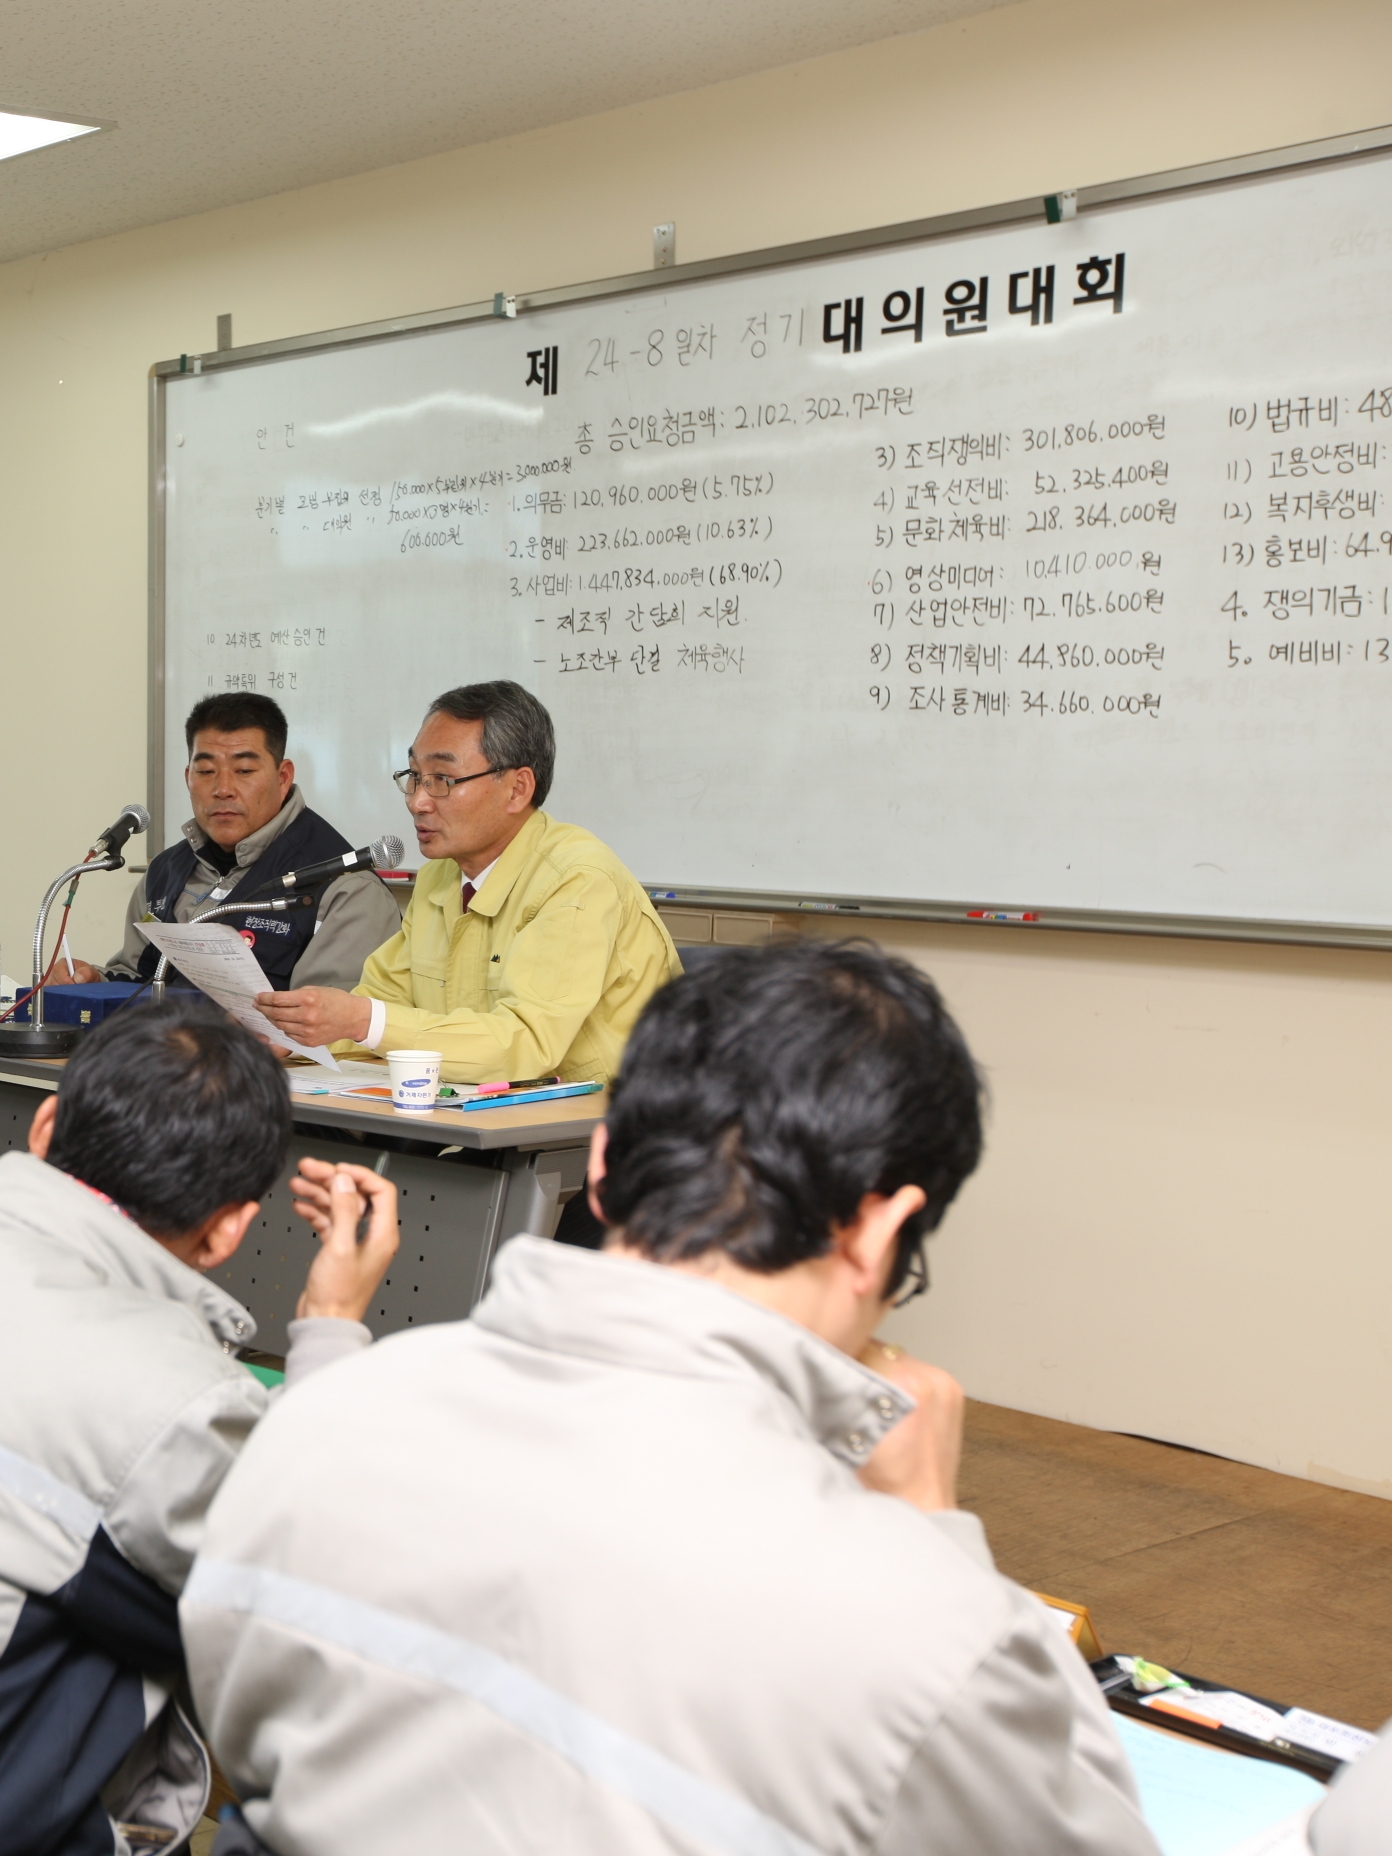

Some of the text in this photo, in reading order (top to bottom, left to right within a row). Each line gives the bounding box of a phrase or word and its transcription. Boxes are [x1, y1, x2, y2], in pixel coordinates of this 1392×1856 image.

[525, 345, 559, 396] 제
[741, 308, 804, 358] 정기
[822, 253, 1126, 354] 대의원대회
